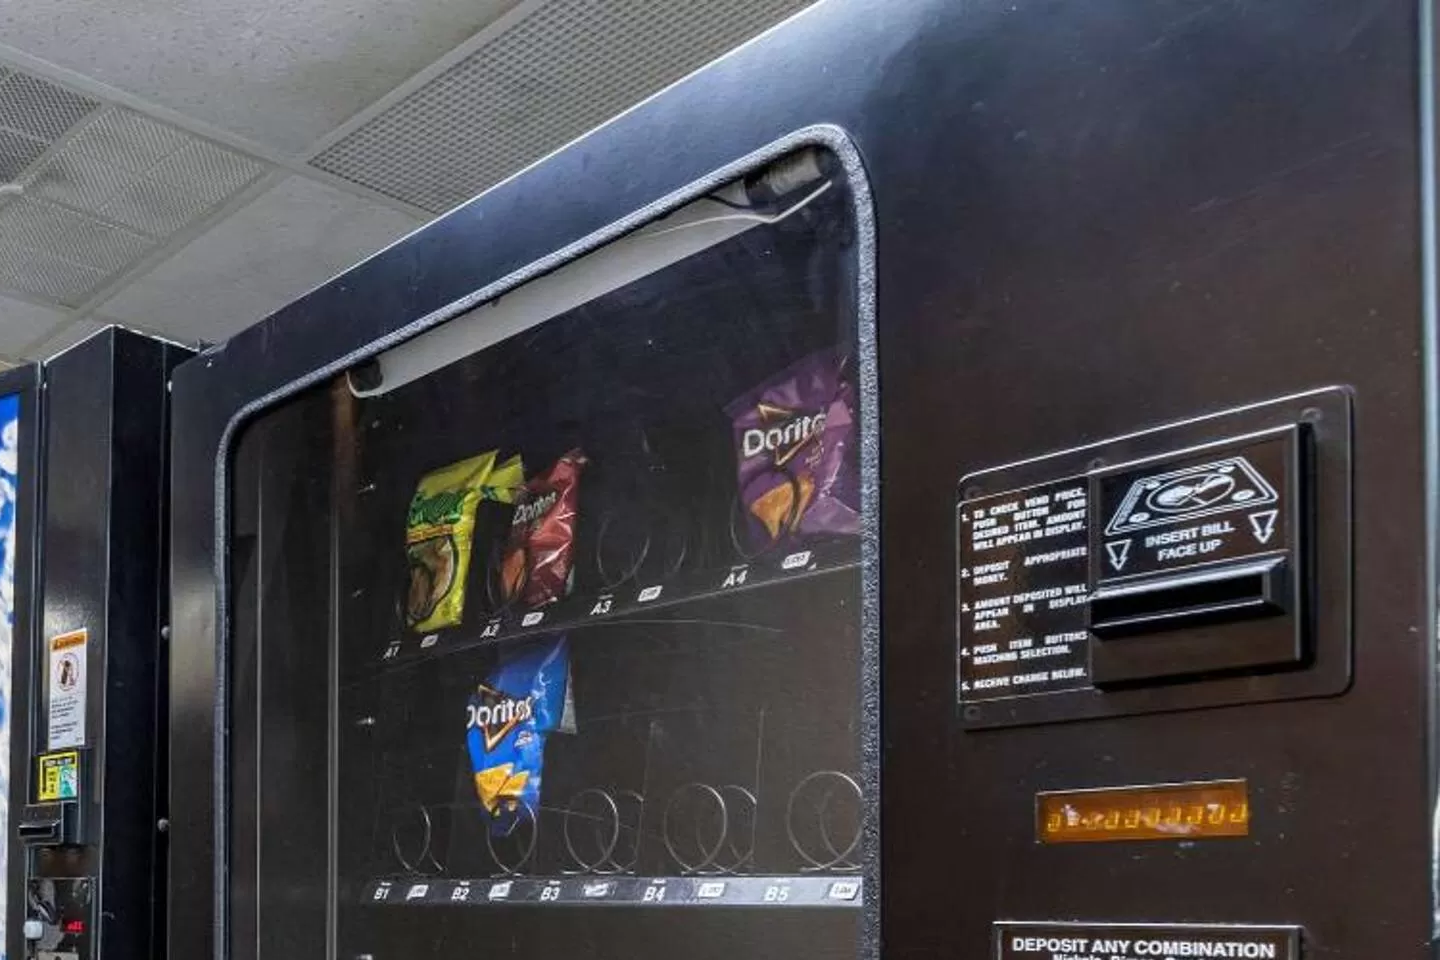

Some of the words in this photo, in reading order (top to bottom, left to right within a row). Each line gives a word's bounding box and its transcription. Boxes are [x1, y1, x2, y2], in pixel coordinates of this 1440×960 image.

[743, 410, 827, 457] Dorito
[972, 518, 997, 530] PUSH
[1013, 506, 1049, 521] BUTTON
[989, 502, 1019, 516] CHECK
[1046, 508, 1086, 525] AMOUNT
[973, 539, 994, 551] WILL
[996, 531, 1031, 546] APPEAR
[1145, 525, 1198, 548] INSERT
[1201, 520, 1234, 539] BILL
[973, 560, 1010, 575] DEPOSIT
[1024, 546, 1087, 566] APPROPRIATE
[1158, 542, 1195, 562] FACE
[1198, 539, 1222, 555] UP
[590, 600, 612, 616] A3
[722, 570, 748, 588] A4
[973, 596, 1011, 610] AMOUNT
[1013, 587, 1063, 604] DEPOSITED
[1064, 583, 1087, 595] WILL
[973, 607, 1009, 620] APPEAR
[972, 643, 998, 655] PUSH
[1009, 638, 1033, 650] ITEM
[1044, 631, 1088, 645] BUTTONS
[972, 651, 1018, 665] MATCHING
[973, 676, 1010, 690] RECEIVE
[1012, 672, 1049, 684] CHANGE
[540, 886, 560, 901] B3
[643, 886, 666, 901] B4
[763, 886, 791, 901] B5
[1012, 937, 1090, 953] DEPOSIT
[1092, 939, 1131, 954] ANY
[1134, 940, 1276, 958] COMBINATION
